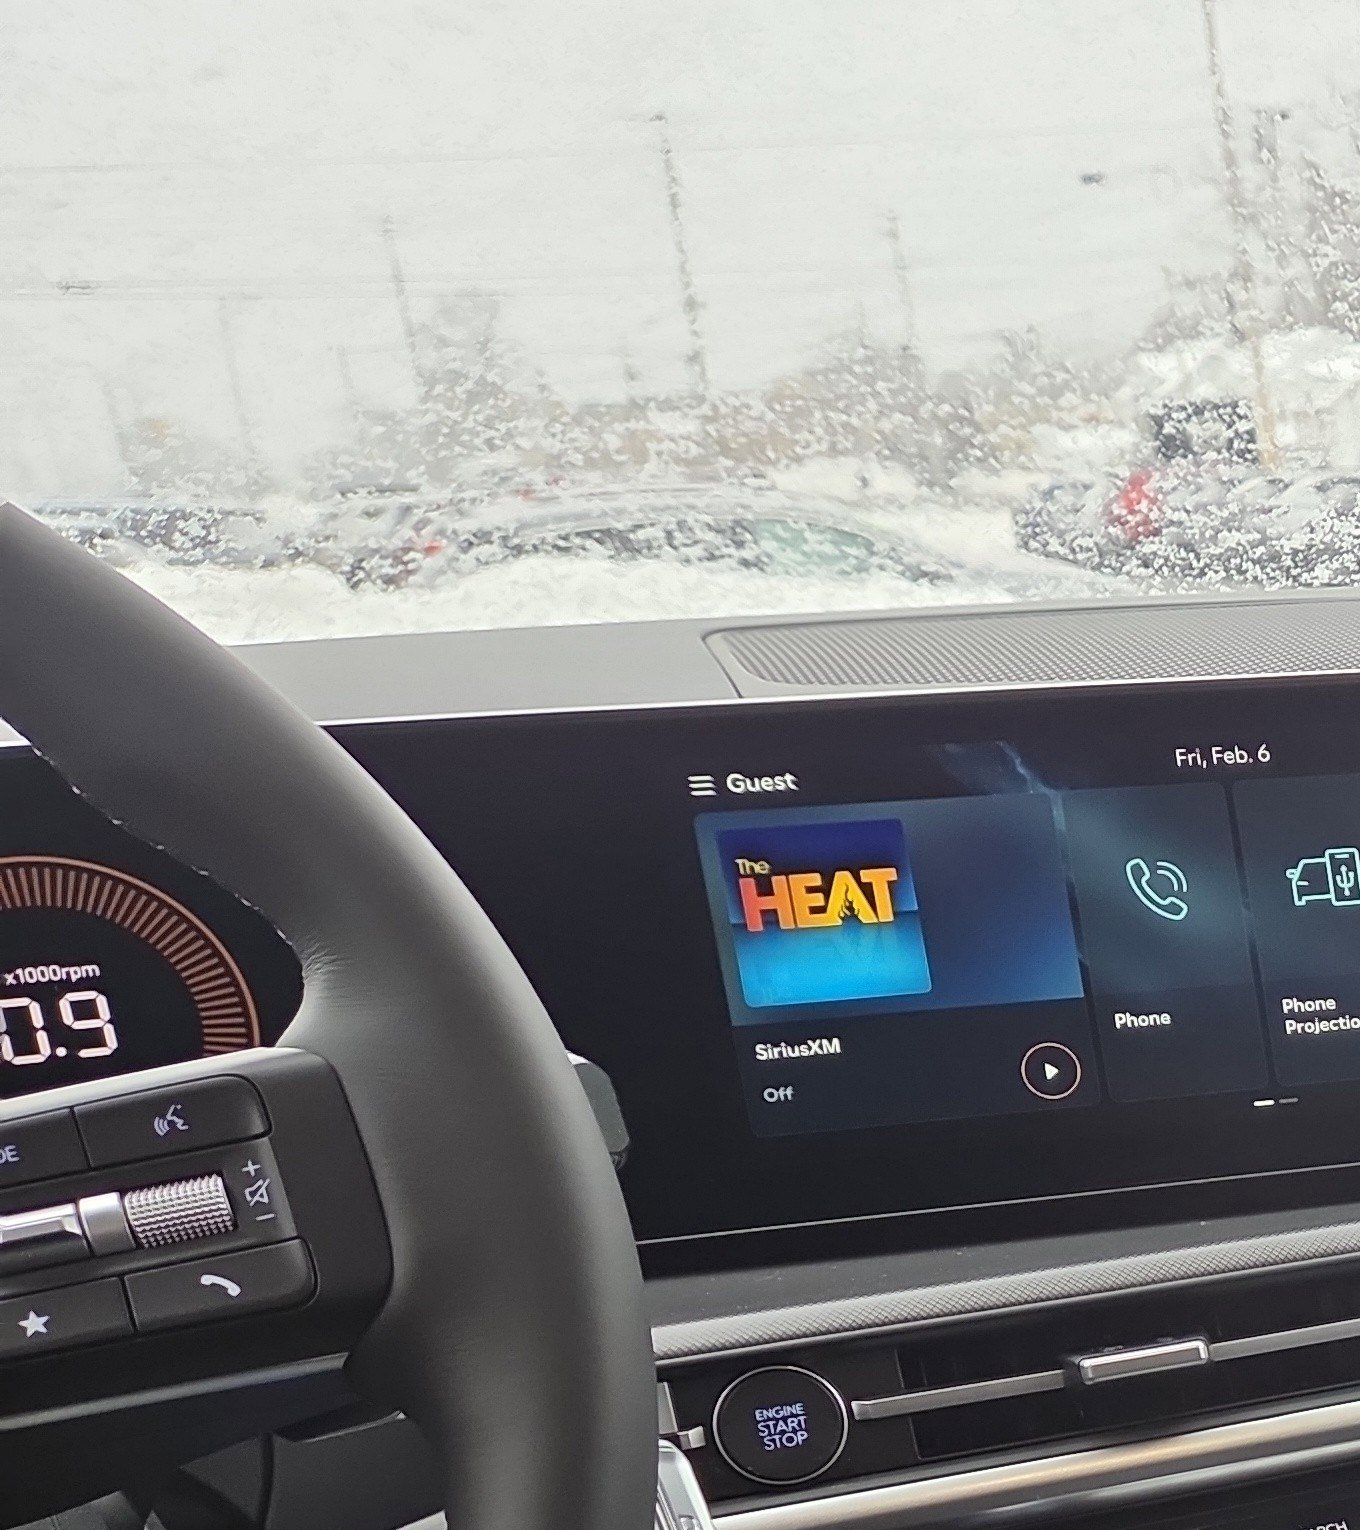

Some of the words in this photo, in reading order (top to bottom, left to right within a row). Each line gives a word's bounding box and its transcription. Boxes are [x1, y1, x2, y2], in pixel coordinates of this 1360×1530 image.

[1175, 747, 1207, 769] Fri,
[1211, 744, 1254, 765] Feb.
[1257, 742, 1271, 763] 6
[726, 772, 799, 794] Guest
[735, 857, 772, 875] The
[738, 866, 898, 932] HEAT
[4, 964, 101, 987] x1000rpm
[1282, 997, 1337, 1014] Phone
[0, 990, 119, 1066] 0.9
[1114, 1011, 1172, 1030] Phone
[755, 1037, 842, 1061] SiriusXM
[763, 1085, 794, 1103] Off
[754, 1402, 806, 1421] ENGINE
[757, 1415, 807, 1437] START
[763, 1430, 809, 1451] STOP
